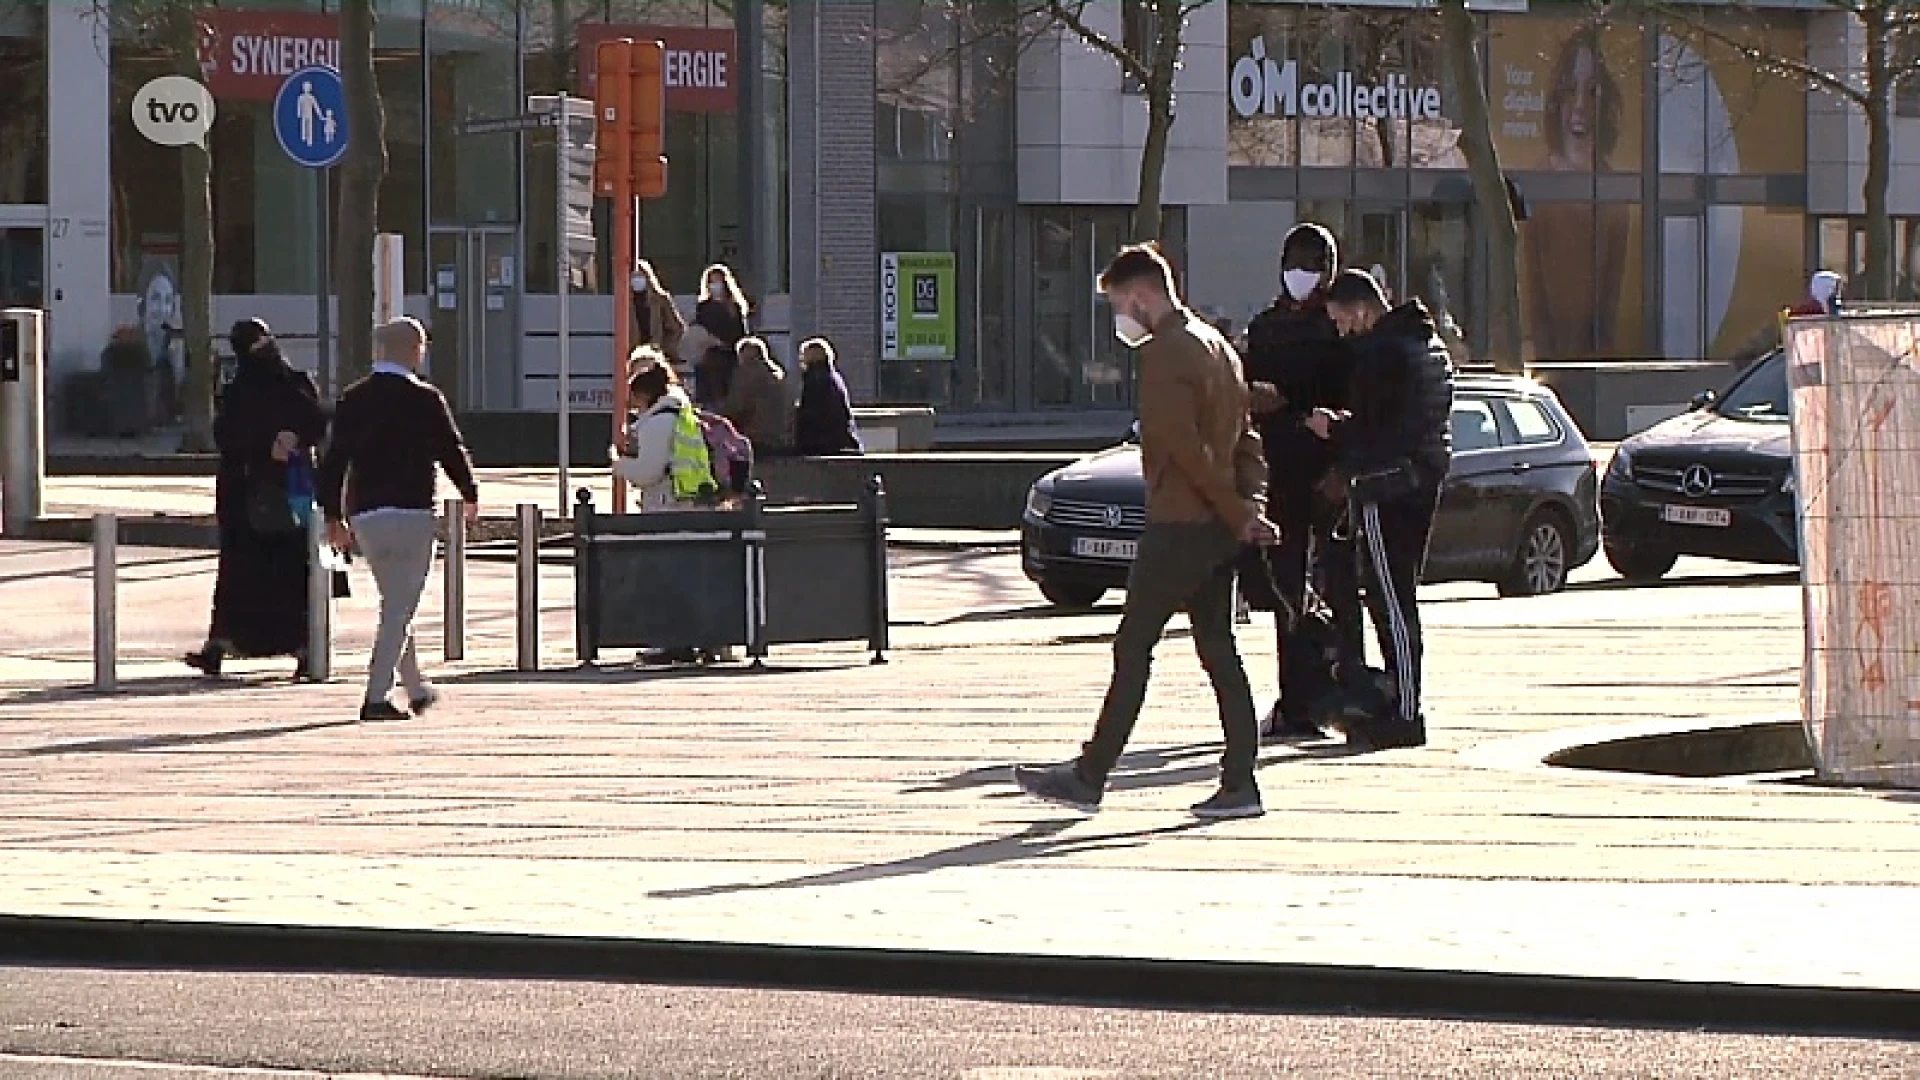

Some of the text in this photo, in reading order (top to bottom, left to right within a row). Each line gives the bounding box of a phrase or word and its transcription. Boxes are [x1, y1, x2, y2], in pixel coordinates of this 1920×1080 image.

[232, 36, 340, 74] SYNERGI
[666, 52, 727, 87] ERGIE
[1504, 65, 1534, 84] Your
[1301, 72, 1441, 118] collective
[52, 218, 70, 238] 27
[885, 258, 896, 353] TE KOOP
